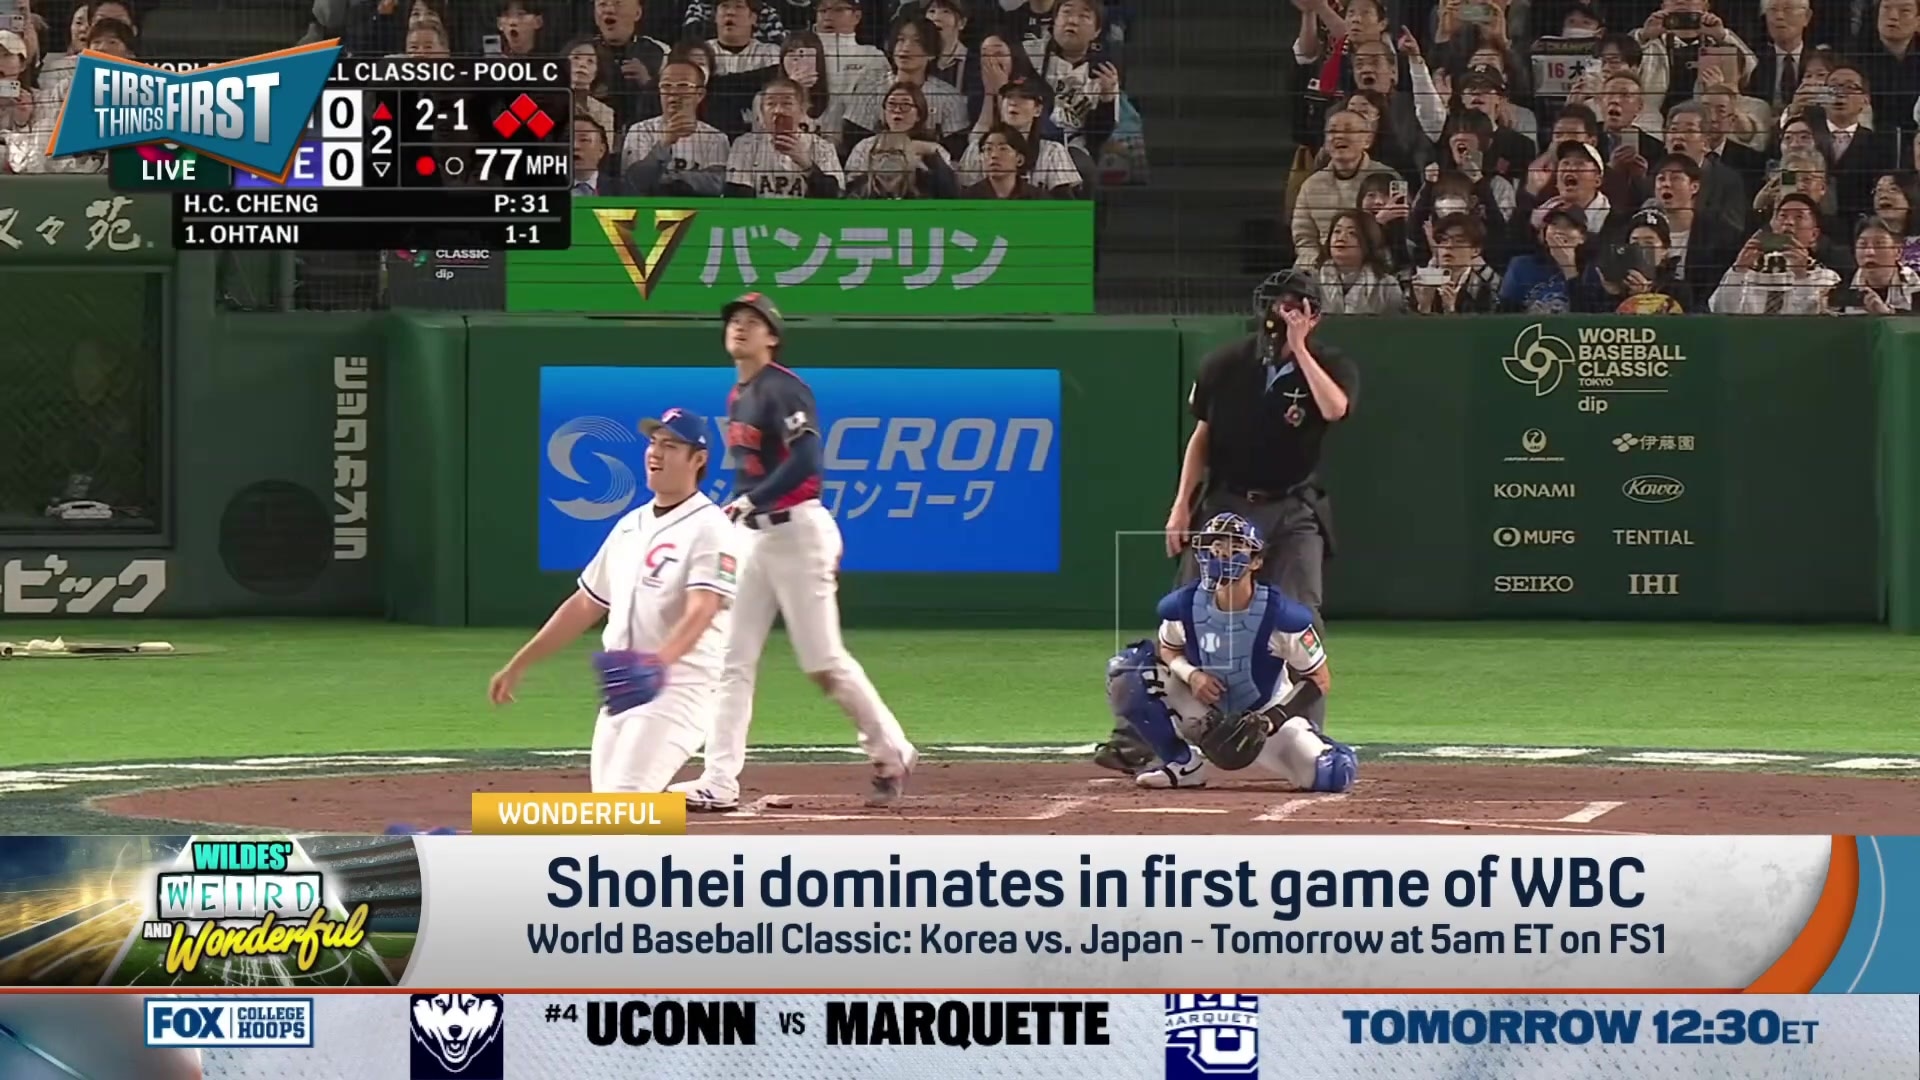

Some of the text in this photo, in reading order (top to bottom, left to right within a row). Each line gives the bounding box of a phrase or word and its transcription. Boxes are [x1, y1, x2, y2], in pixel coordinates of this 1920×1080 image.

[435, 249, 489, 259] CLASSIC
[699, 225, 1009, 291] バンテリン
[435, 269, 454, 280] dip
[1578, 328, 1656, 344] WORLD
[1578, 345, 1687, 361] BASEBALL
[1578, 361, 1670, 377] CLASSIC
[1578, 378, 1614, 387] TOKYO
[1578, 396, 1608, 414] dip
[1640, 434, 1696, 451] 伊藤園
[1493, 483, 1576, 498] KONAMI
[1627, 479, 1682, 497] Kowa
[1524, 530, 1576, 545] MUFG
[1612, 529, 1695, 545] TENTIAL
[0, 554, 166, 613] ビック
[1494, 575, 1574, 593] SEIKO
[1628, 573, 1680, 595] IHI
